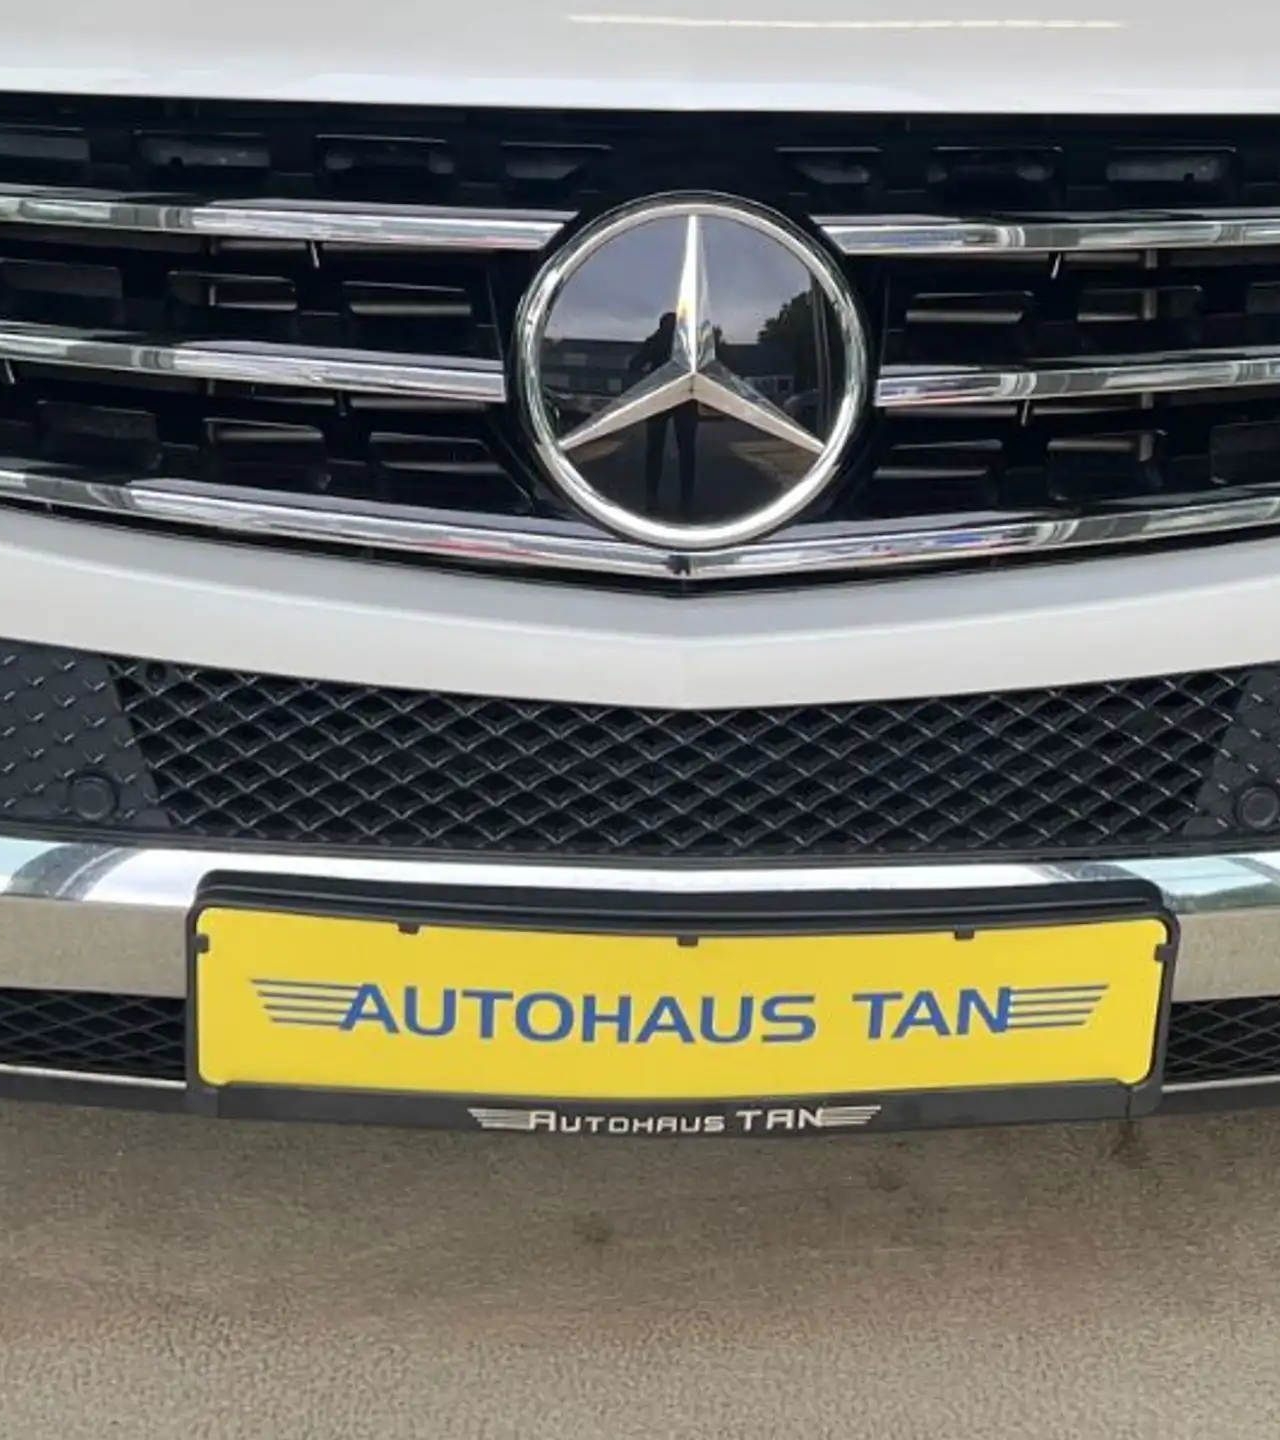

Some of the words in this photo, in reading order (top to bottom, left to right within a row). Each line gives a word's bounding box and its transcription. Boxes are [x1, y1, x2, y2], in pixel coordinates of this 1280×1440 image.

[339, 983, 816, 1044] AUTOHAUS
[852, 986, 1012, 1040] TAN
[736, 1107, 823, 1132] TAN
